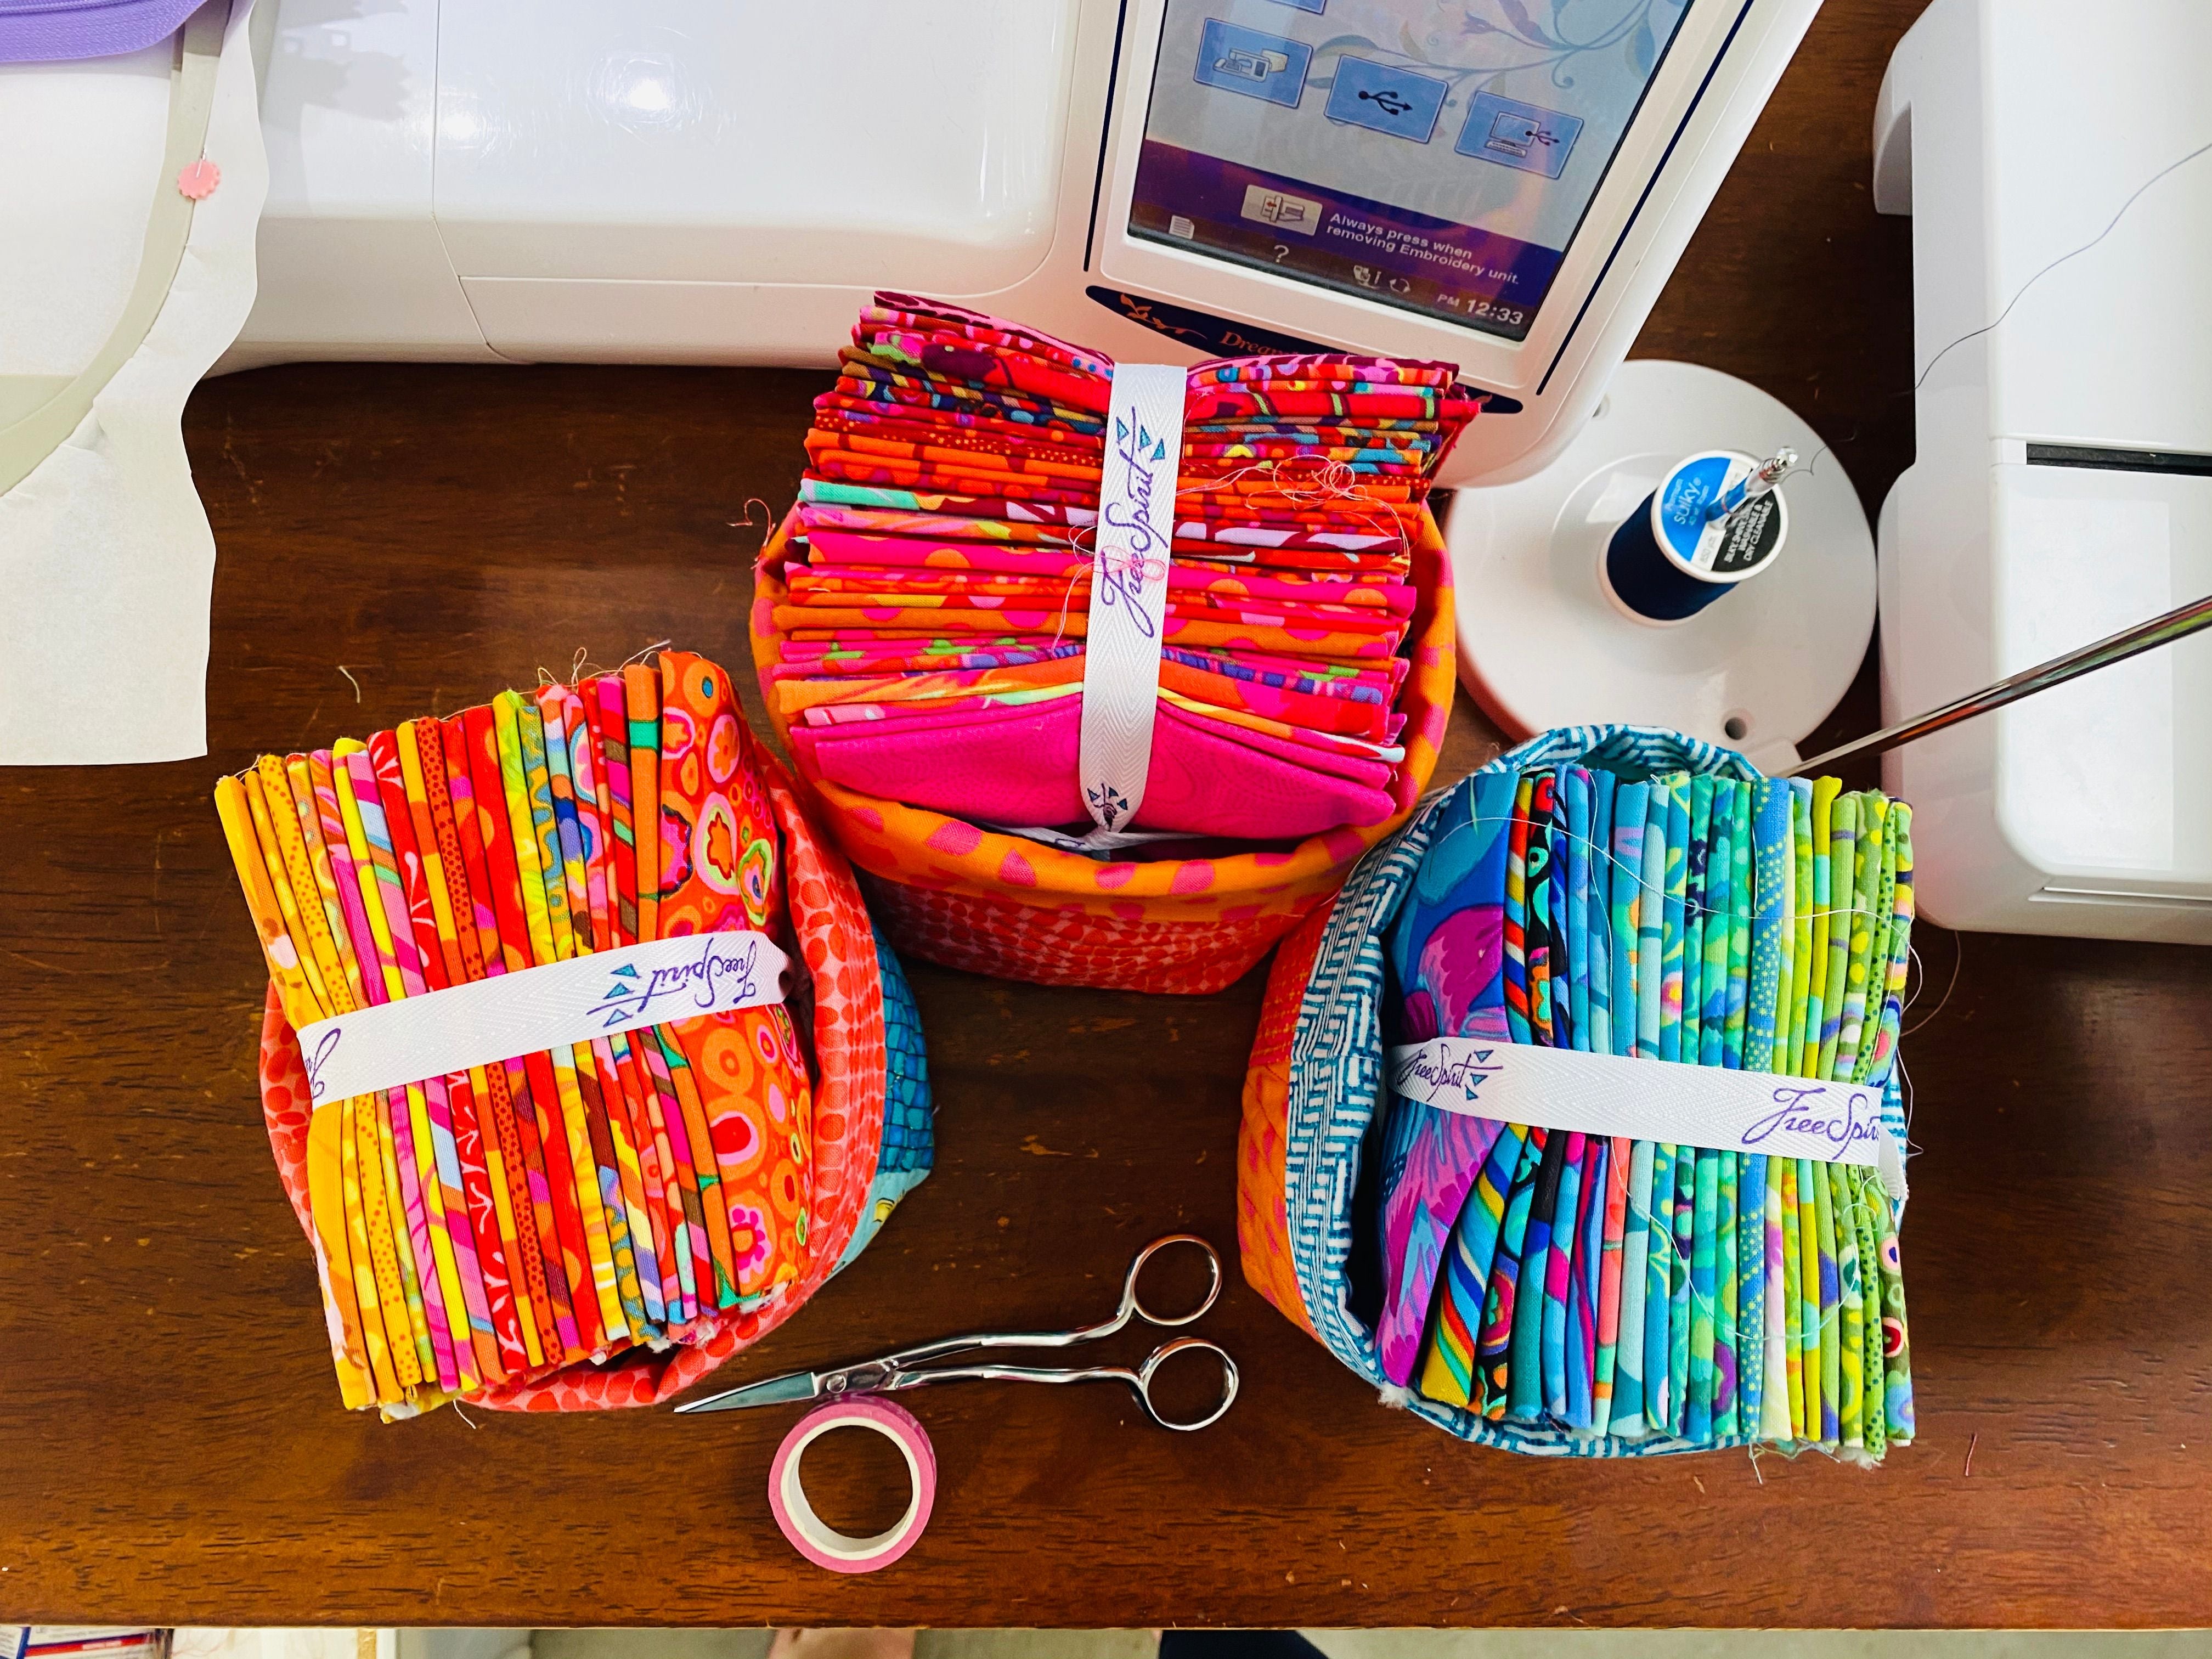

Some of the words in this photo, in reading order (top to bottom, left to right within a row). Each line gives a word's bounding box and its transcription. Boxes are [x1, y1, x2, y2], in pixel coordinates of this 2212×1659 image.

[1327, 225, 1396, 252] removing
[1400, 245, 1485, 276] Embroidery
[1488, 268, 1520, 285] unit.
[1330, 213, 1383, 235] Always
[1386, 229, 1429, 247] press
[1433, 240, 1472, 259] when
[1437, 294, 1460, 307] PM
[1467, 299, 1524, 325] 12:33
